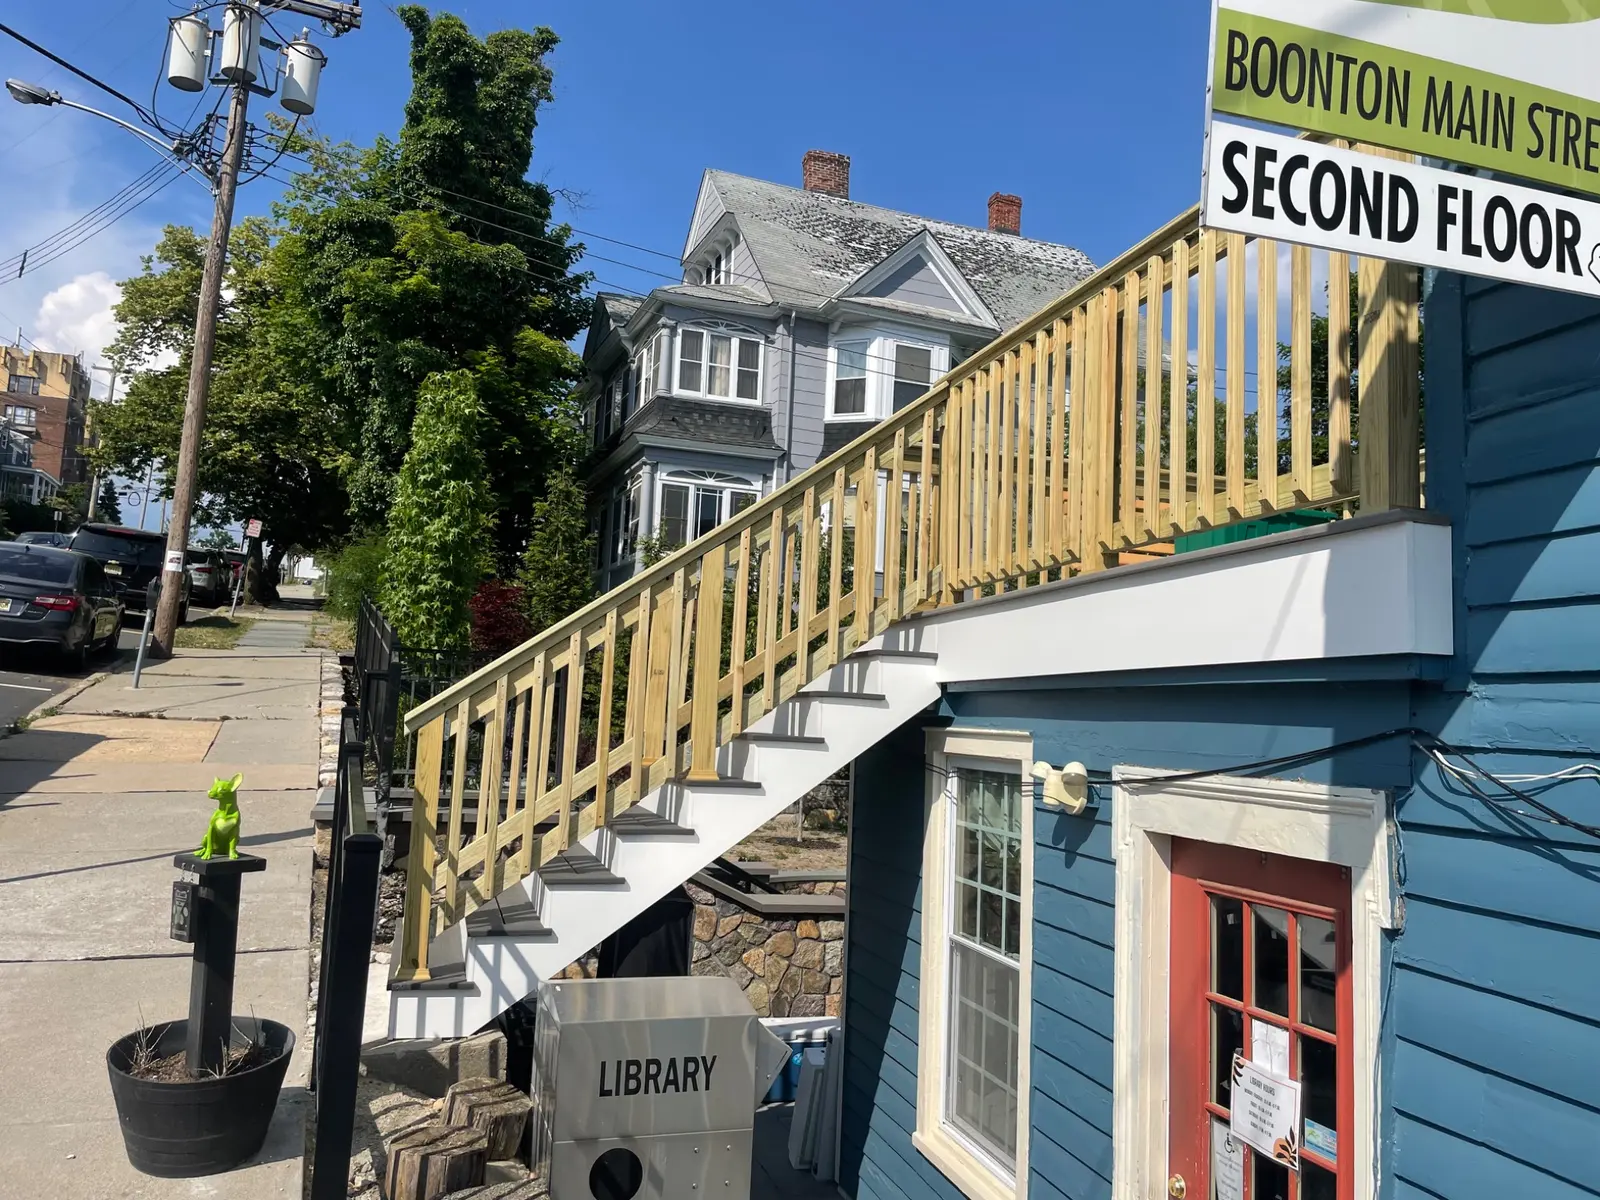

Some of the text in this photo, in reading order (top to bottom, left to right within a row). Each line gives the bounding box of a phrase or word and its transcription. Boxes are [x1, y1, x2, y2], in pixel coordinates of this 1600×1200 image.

[1225, 29, 1600, 174] BOONTON MAIN STRE
[1221, 140, 1583, 277] SECOND FLOOR
[599, 1055, 718, 1097] LIBRARY
